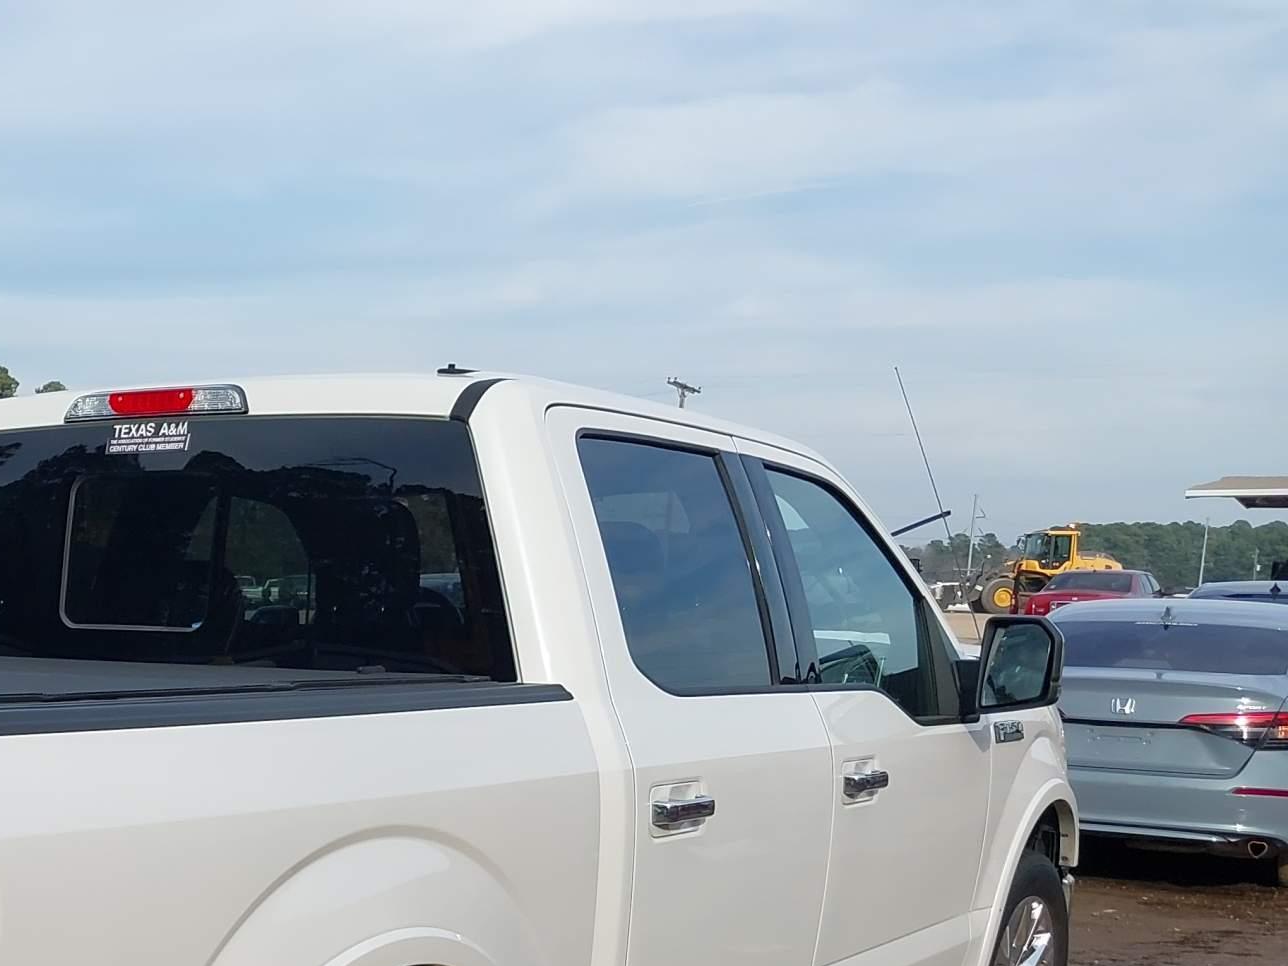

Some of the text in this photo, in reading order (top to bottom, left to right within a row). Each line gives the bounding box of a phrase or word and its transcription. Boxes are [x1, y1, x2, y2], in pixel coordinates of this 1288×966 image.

[113, 421, 188, 438] TEXAS A&M
[109, 444, 138, 453] CENTURY
[156, 442, 184, 450] MEMBER
